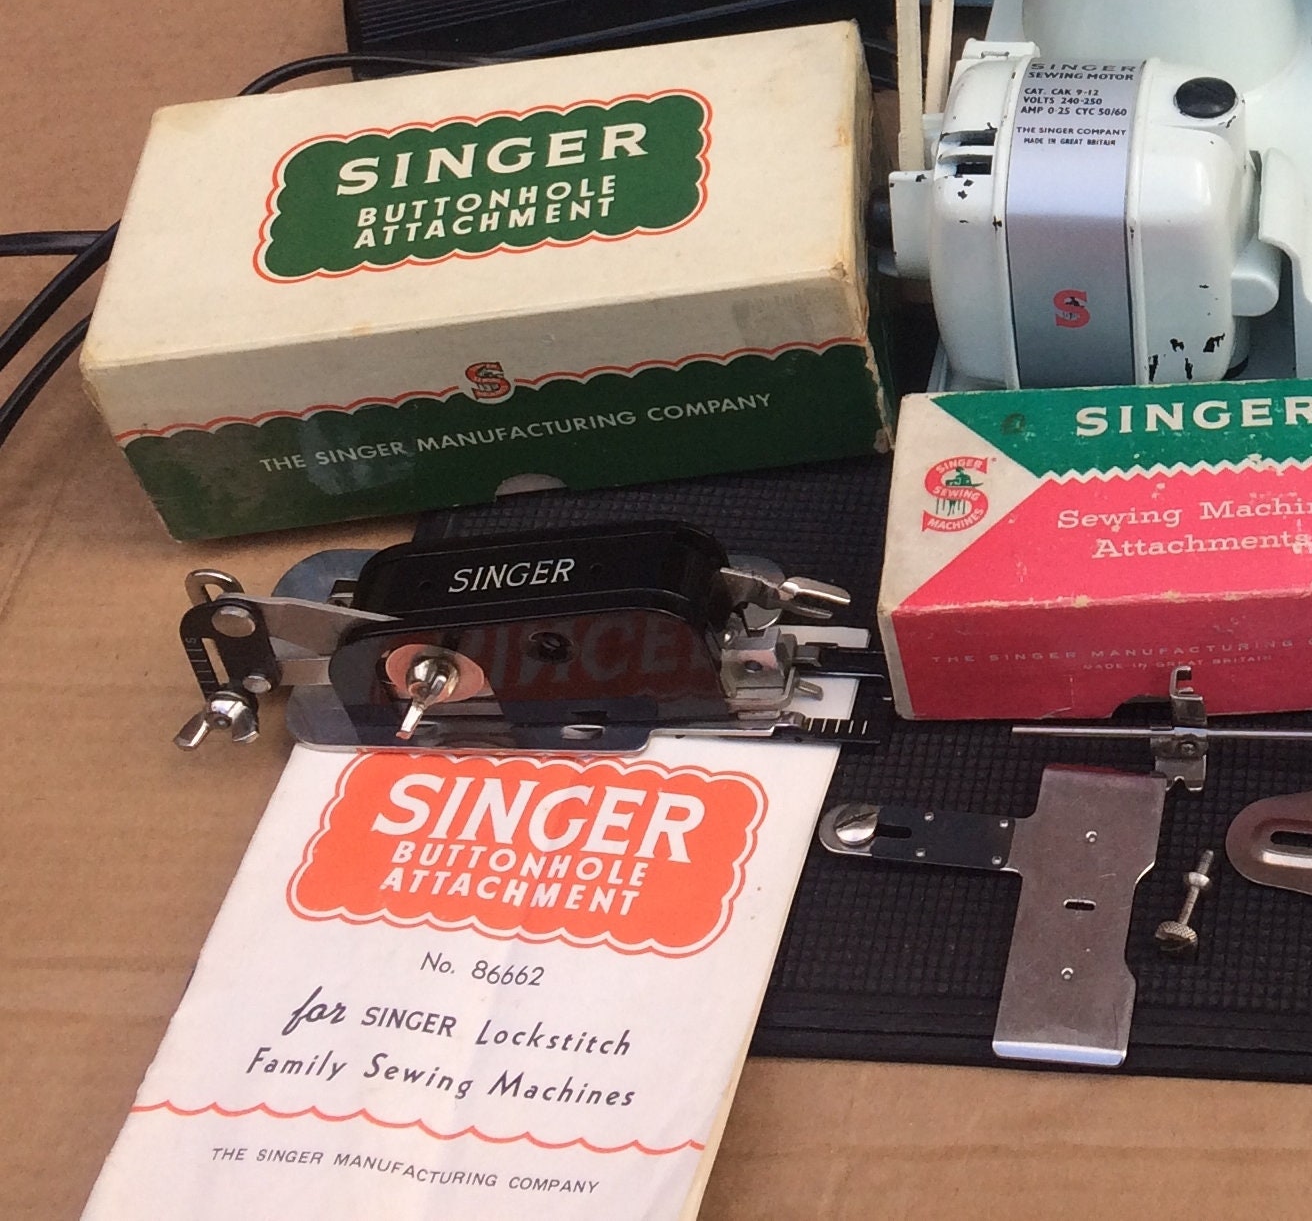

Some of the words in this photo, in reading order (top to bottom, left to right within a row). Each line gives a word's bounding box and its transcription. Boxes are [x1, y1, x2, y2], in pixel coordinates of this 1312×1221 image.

[1028, 71, 1083, 80] SEWING
[1086, 73, 1134, 81] MOTOR
[1031, 63, 1136, 72] SINGER
[1020, 106, 1044, 115] AMP
[1075, 107, 1095, 116] CYC
[1098, 107, 1128, 117] 50/60
[1023, 96, 1055, 105] VOLTS
[1060, 97, 1103, 106] 240-250
[1016, 126, 1036, 134] THE
[1038, 126, 1074, 135] SINGER
[1076, 128, 1127, 136] COMPANY
[1023, 137, 1044, 145] MADE
[1048, 137, 1056, 145] IN
[1060, 138, 1084, 146] GREAT
[1086, 138, 1117, 147] BRITAIN
[336, 121, 649, 197] SINGER
[357, 174, 617, 228] BUTTONHOLE
[353, 196, 616, 250] ATTACHMENT
[259, 455, 307, 474] THE
[314, 440, 408, 467] SINGER
[416, 409, 637, 453] MANUFACTURING
[646, 392, 773, 423] COMPANY
[935, 458, 983, 474] SINGER
[932, 485, 981, 502] SEWING
[927, 508, 984, 531] MACHINES
[1057, 506, 1183, 530] Sewing
[1091, 529, 1312, 559] Attachments
[448, 557, 576, 594] SINGER
[931, 654, 975, 663] THE
[989, 651, 1077, 662] SINGER
[1091, 639, 1293, 659] MANUFACTURING
[1083, 662, 1123, 671] MADE
[1212, 654, 1273, 665] BRITAIN
[371, 772, 706, 864] SINGER
[391, 840, 649, 888] BUTTONHOLE
[379, 867, 640, 916] ATTACHMENT
[420, 951, 456, 975] No.
[471, 960, 546, 987] 86662
[281, 985, 348, 1037] for
[360, 1006, 458, 1038] SINGER
[475, 1019, 632, 1057] Lockstitch
[246, 1046, 348, 1082] Family
[363, 1052, 474, 1100] Sewing
[487, 1069, 637, 1108] Machines
[211, 1147, 249, 1162] THE
[256, 1148, 325, 1166] SINGER
[333, 1152, 499, 1189] MANUFACTURING
[508, 1175, 600, 1195] COMPANY
